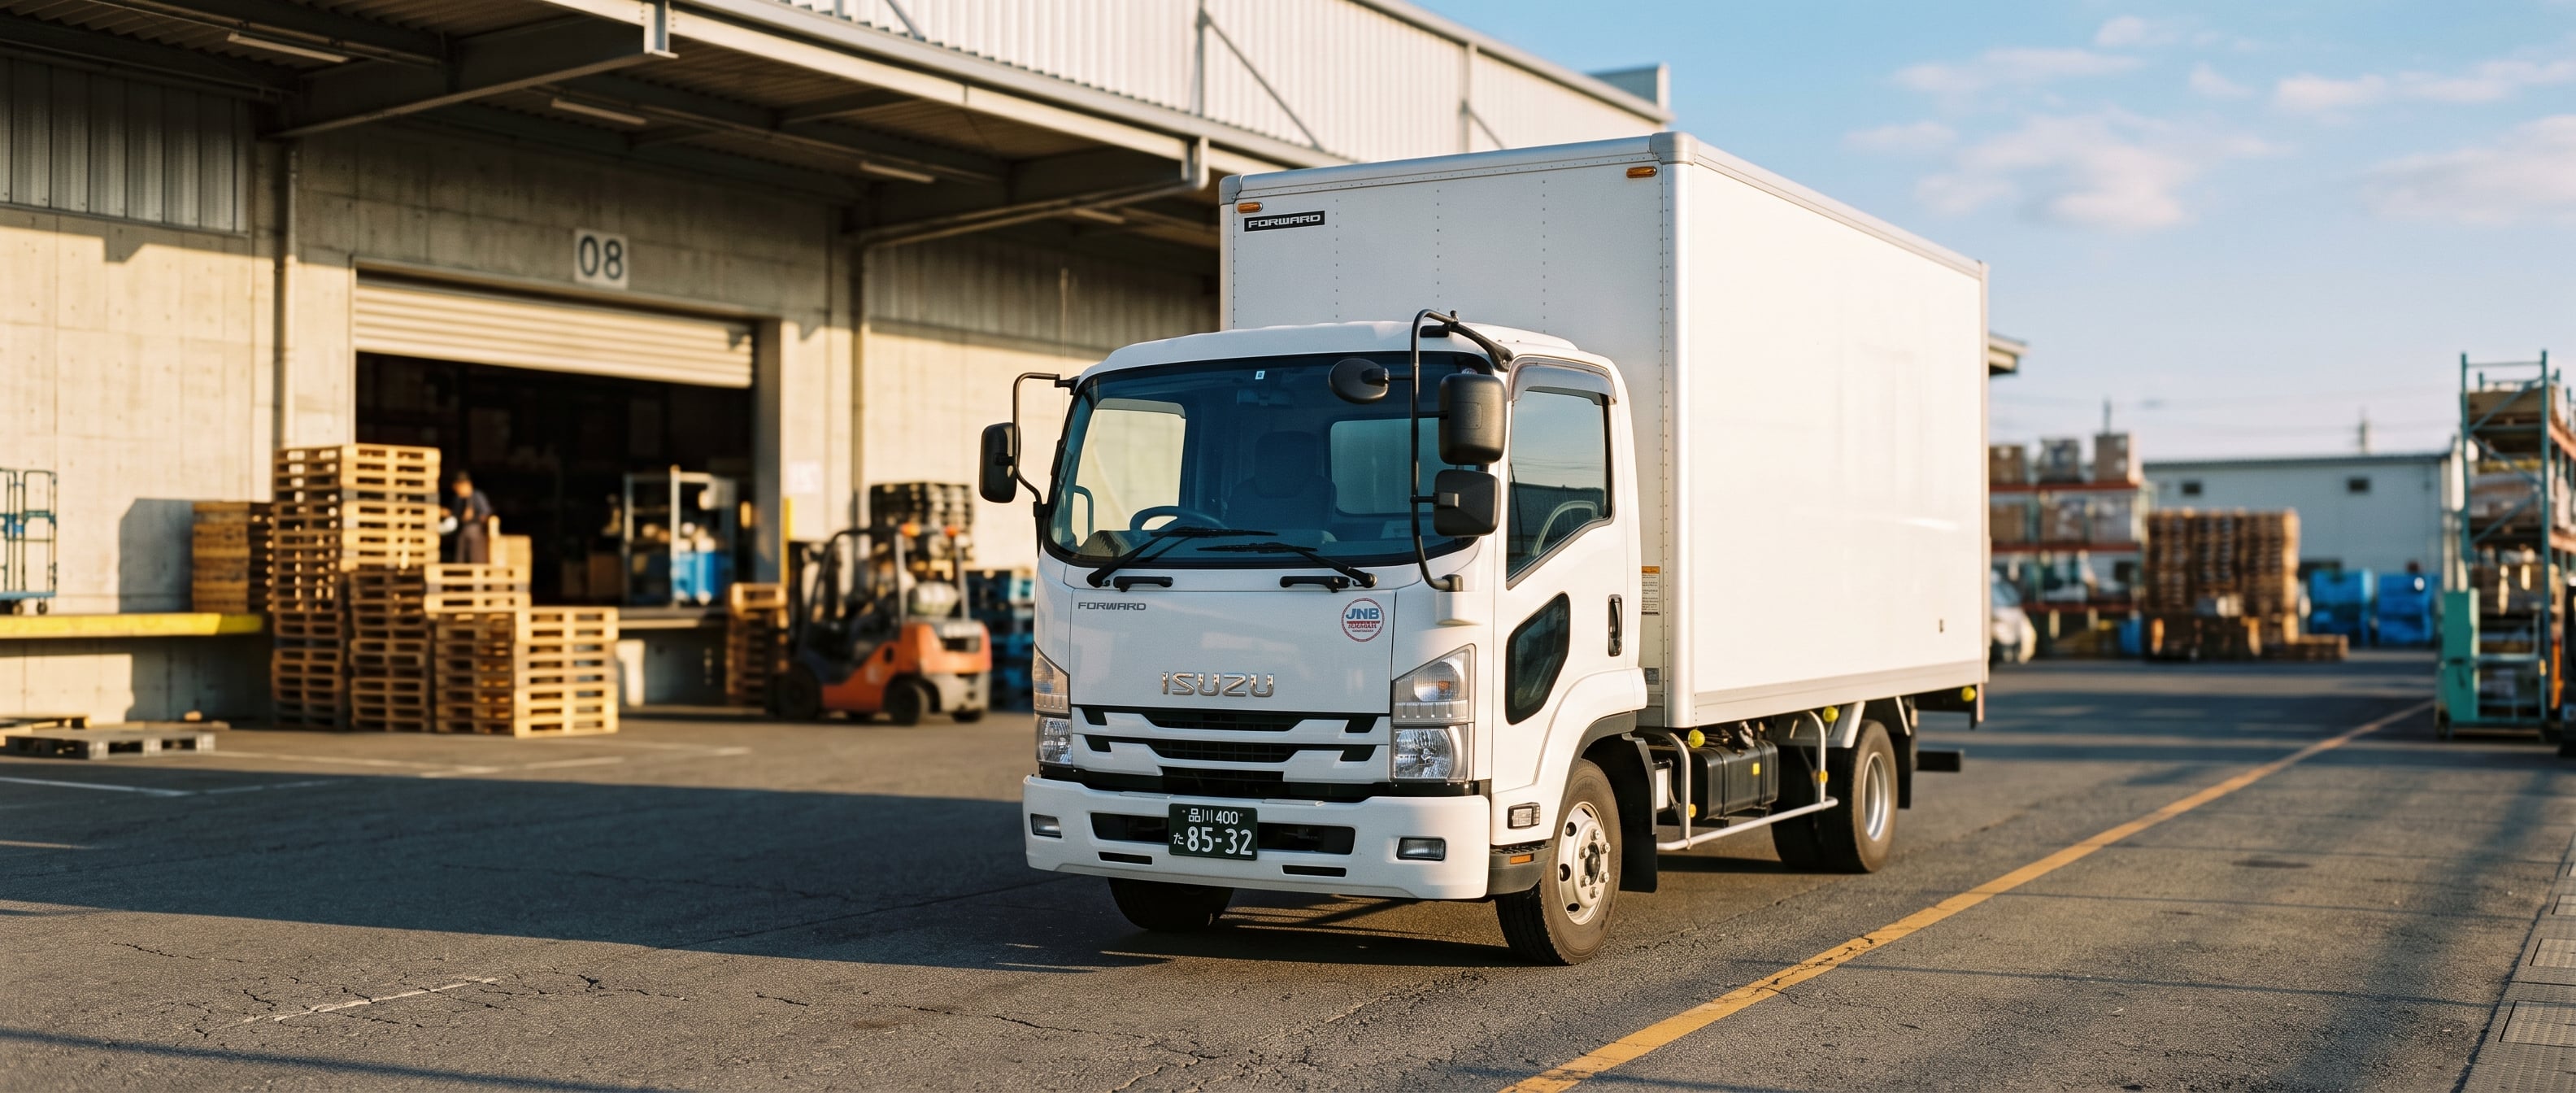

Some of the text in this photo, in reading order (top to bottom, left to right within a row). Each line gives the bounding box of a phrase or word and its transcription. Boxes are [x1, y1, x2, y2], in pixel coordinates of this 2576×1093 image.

[1248, 214, 1321, 229] FORWARD
[579, 234, 623, 281] 08
[1077, 602, 1147, 611] FORWARD
[1345, 607, 1380, 620] JNB
[1162, 671, 1274, 698] ISUZU
[1188, 808, 1238, 825] 品川 400
[1173, 825, 1253, 856] た 85-32
